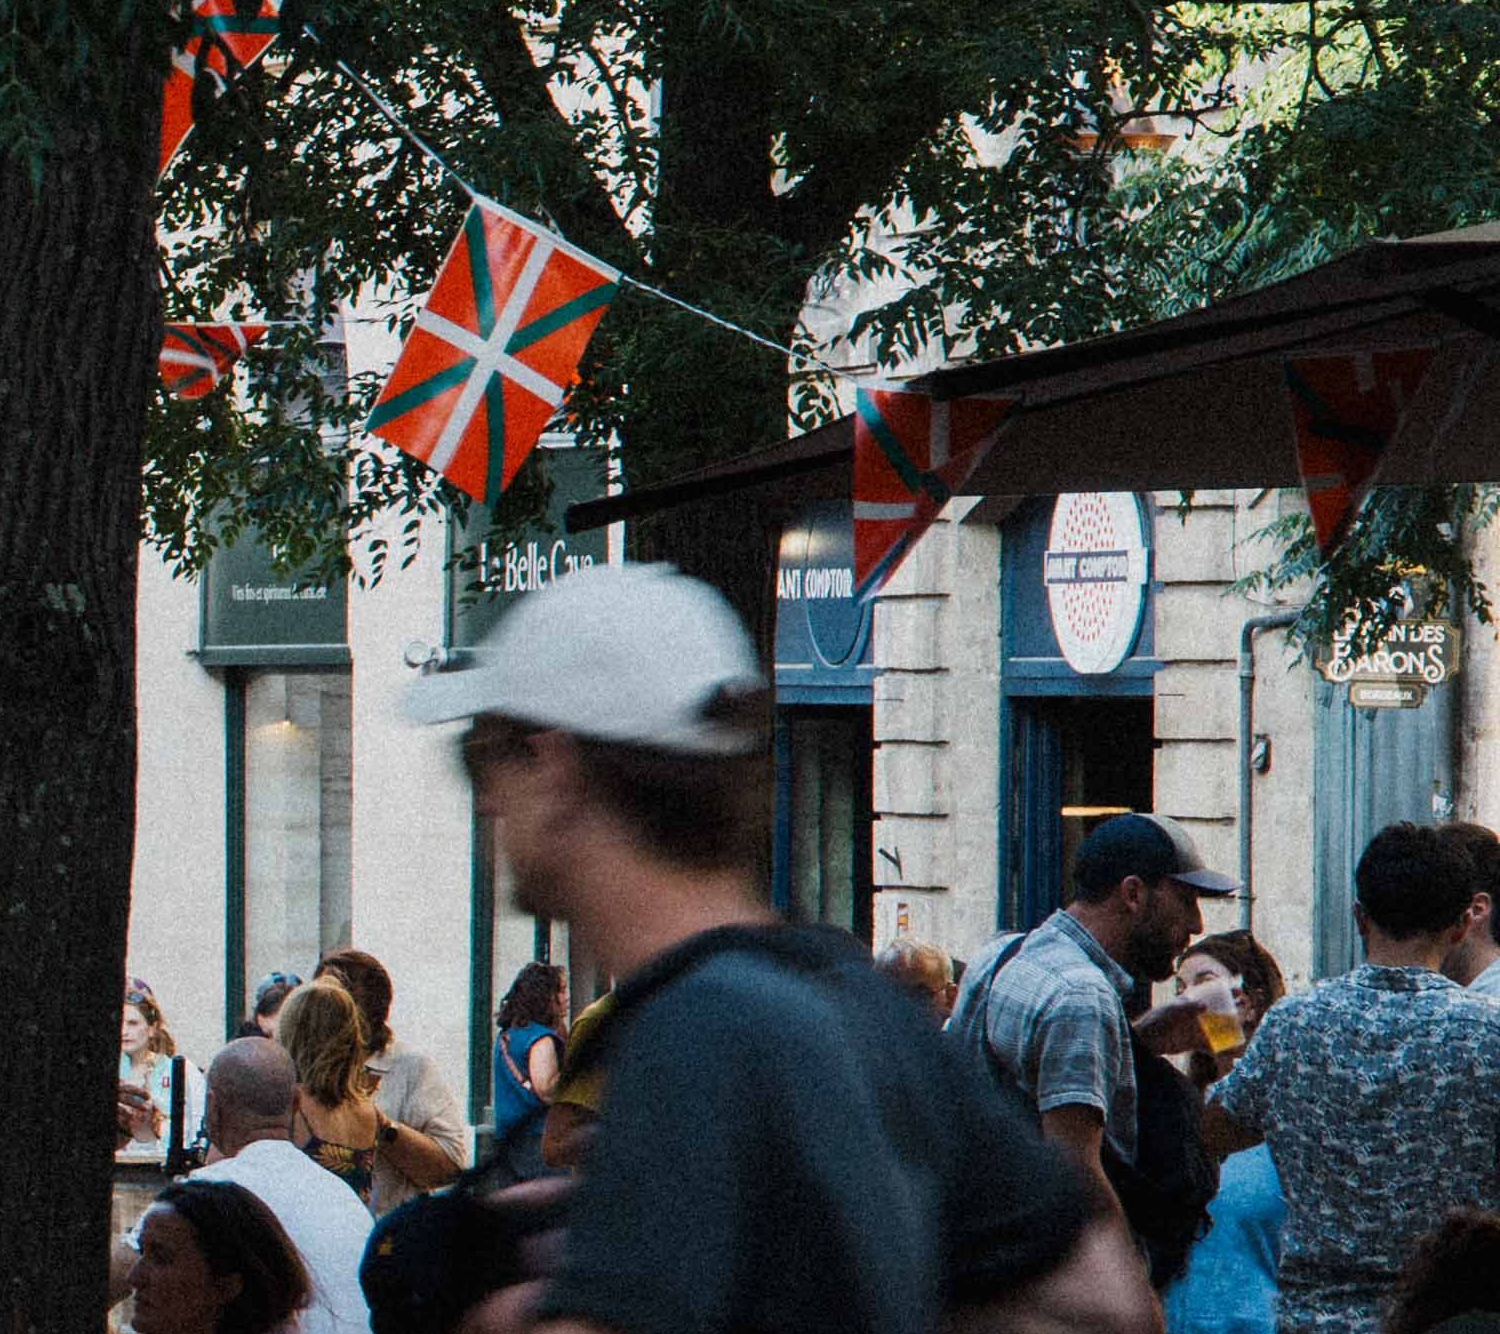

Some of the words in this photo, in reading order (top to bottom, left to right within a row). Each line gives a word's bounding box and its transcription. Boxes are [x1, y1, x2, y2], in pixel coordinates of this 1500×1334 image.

[504, 541, 549, 592] Belle
[804, 568, 854, 599] COMPTOIR
[1409, 624, 1446, 643] DES
[1327, 637, 1446, 683] BARONS
